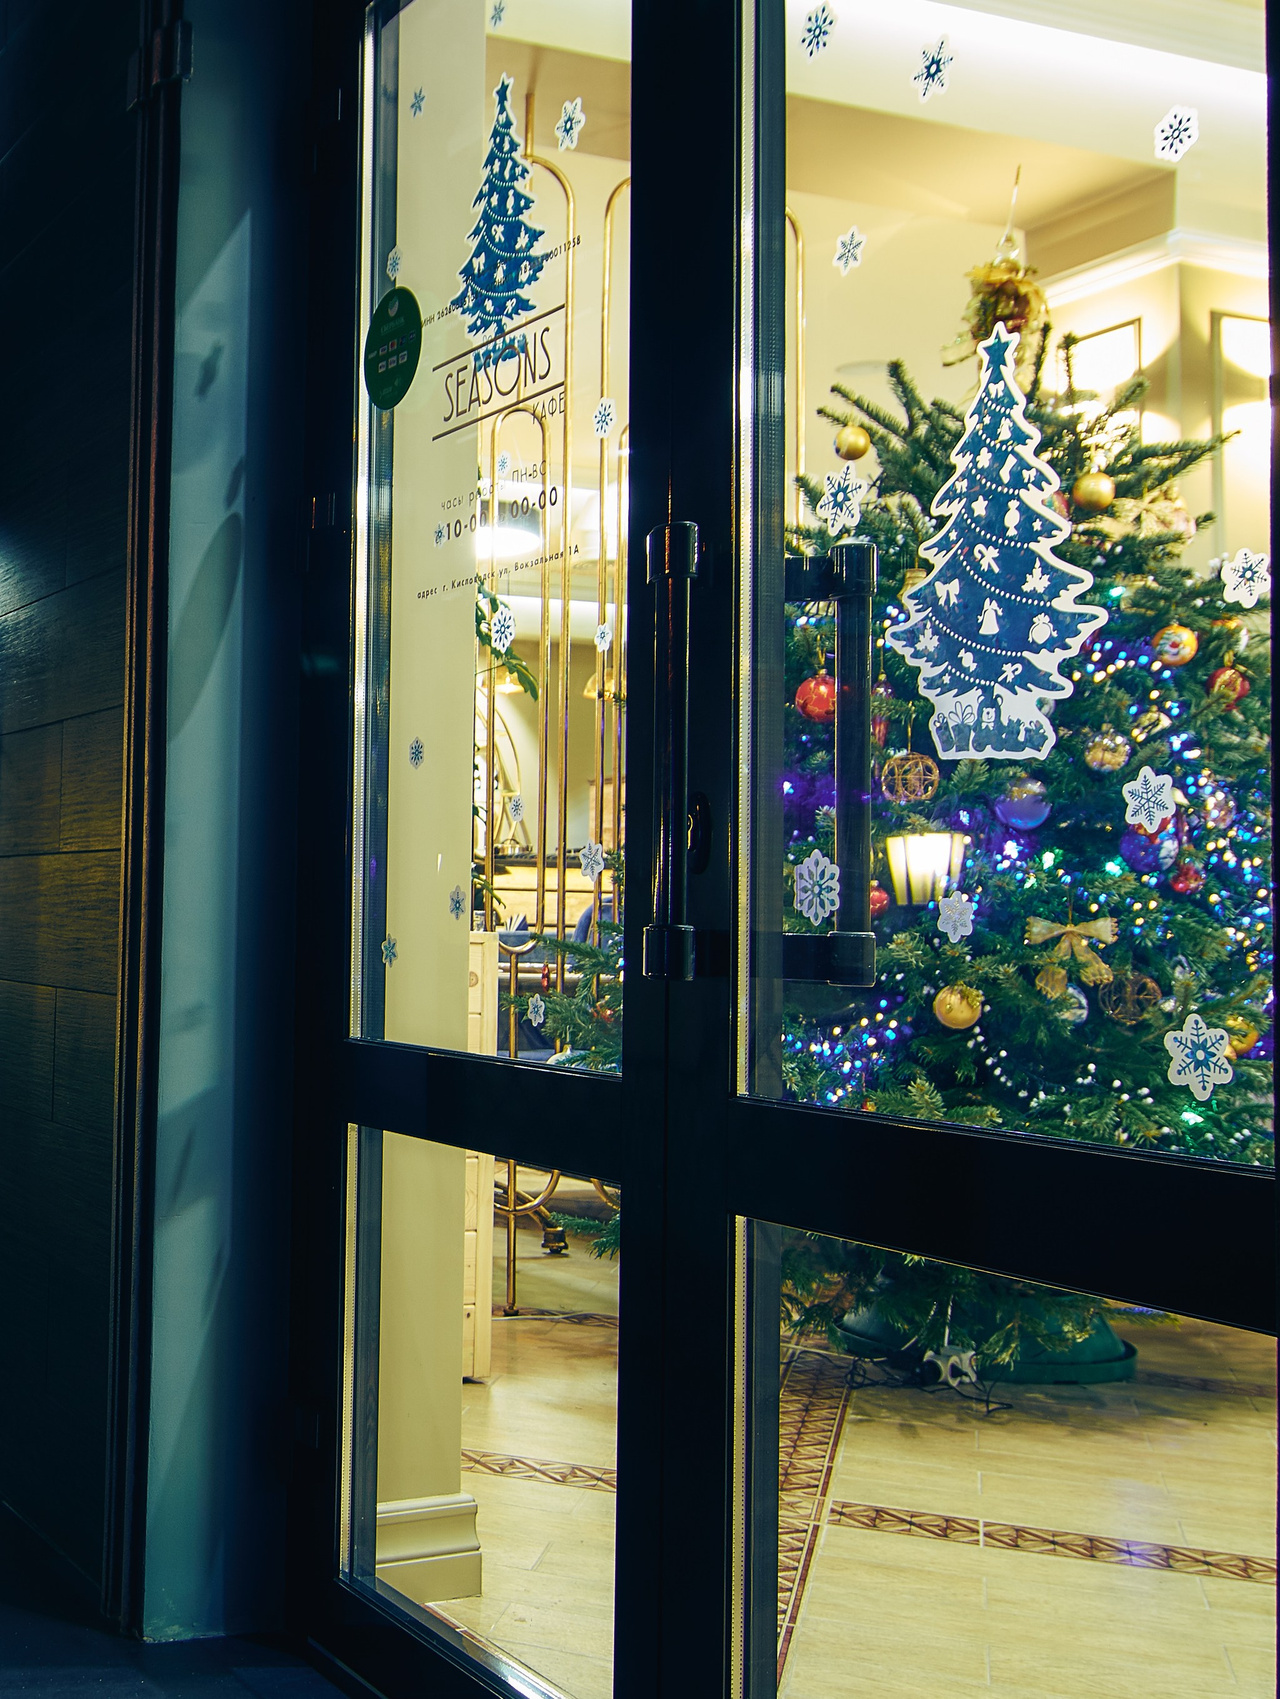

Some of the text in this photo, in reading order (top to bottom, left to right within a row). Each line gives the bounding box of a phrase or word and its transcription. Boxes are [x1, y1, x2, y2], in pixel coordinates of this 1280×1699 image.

[443, 326, 551, 422] SEASONS
[532, 391, 565, 424] КАФЕ
[440, 494, 464, 511] часы
[511, 459, 547, 484] ПН-ВС
[446, 511, 487, 540] 10-00
[511, 485, 558, 519] 00-00
[417, 586, 438, 600] адрес
[514, 550, 564, 572] Вокзальная
